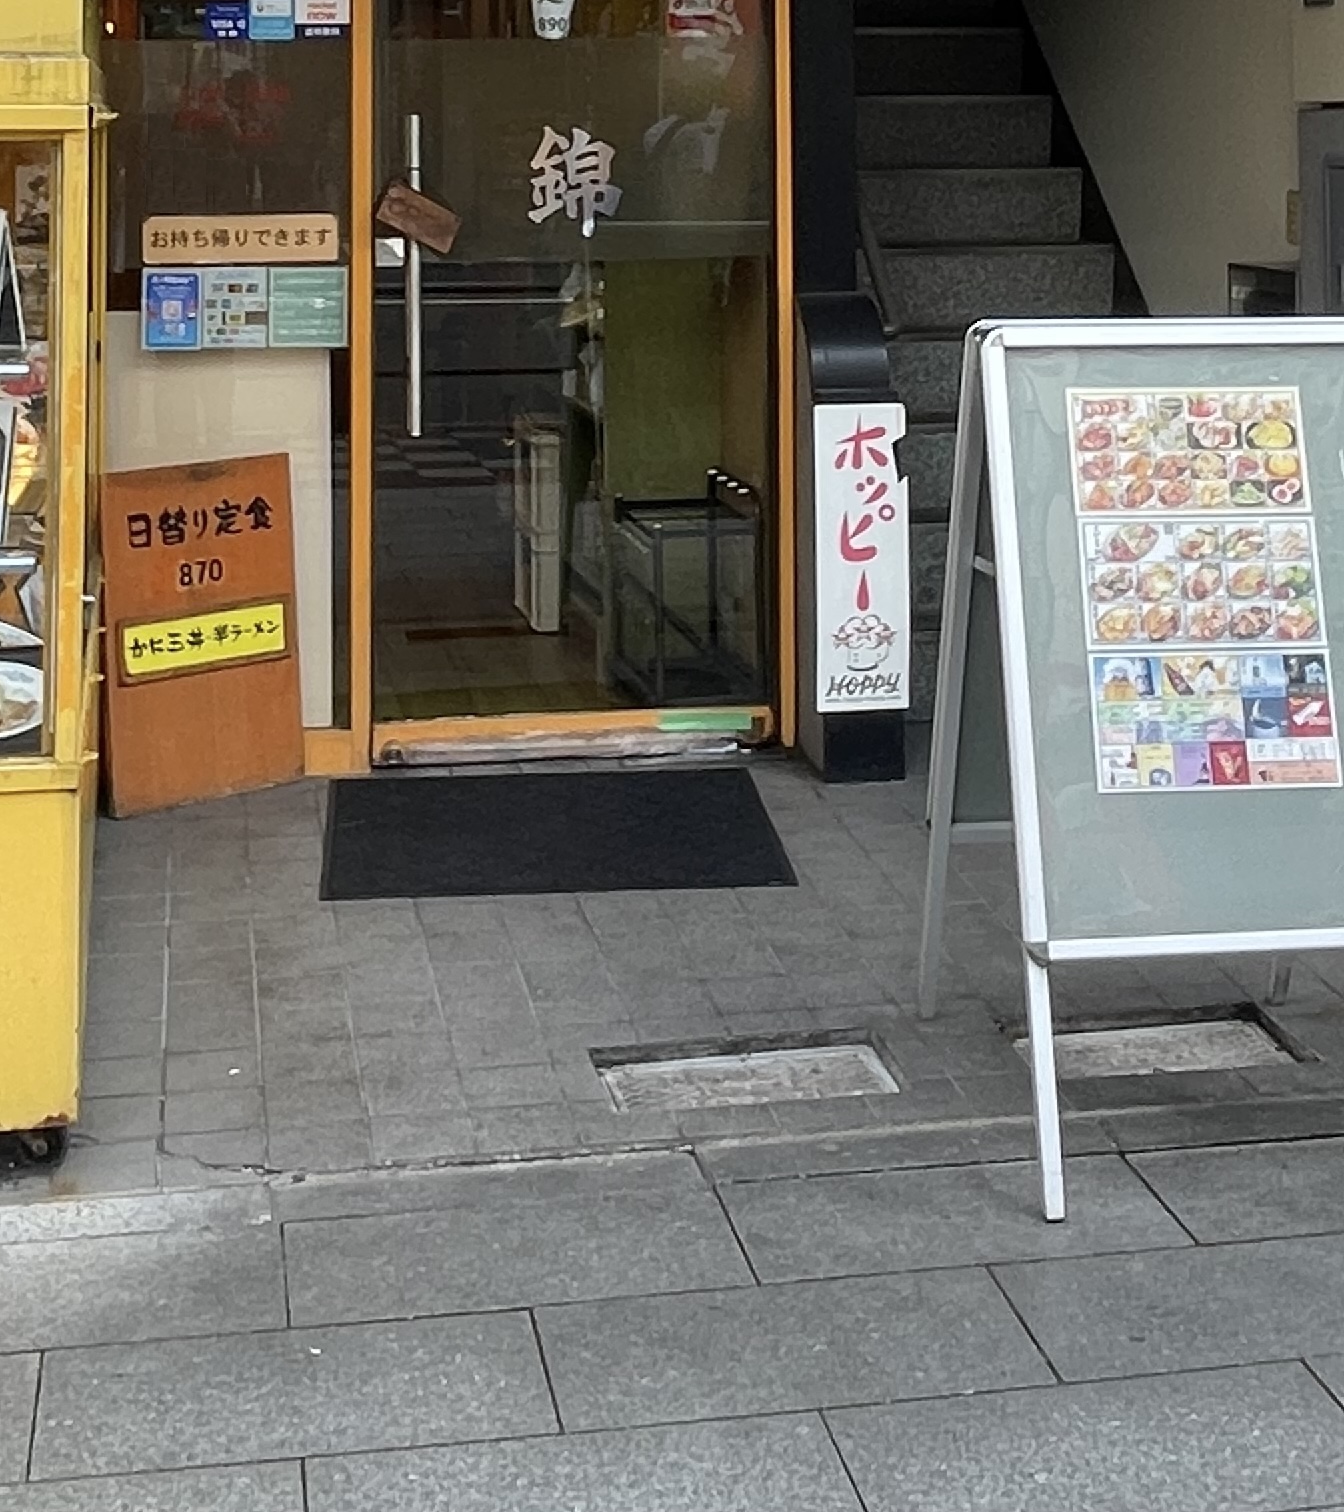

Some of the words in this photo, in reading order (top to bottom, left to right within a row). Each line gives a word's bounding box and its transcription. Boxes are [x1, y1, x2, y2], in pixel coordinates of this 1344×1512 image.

[527, 125, 624, 238] 錦
[150, 228, 332, 249] お持ち帰りできます
[126, 495, 274, 549] 日替り定食
[834, 412, 896, 613] ホッピー
[179, 558, 224, 587] 870
